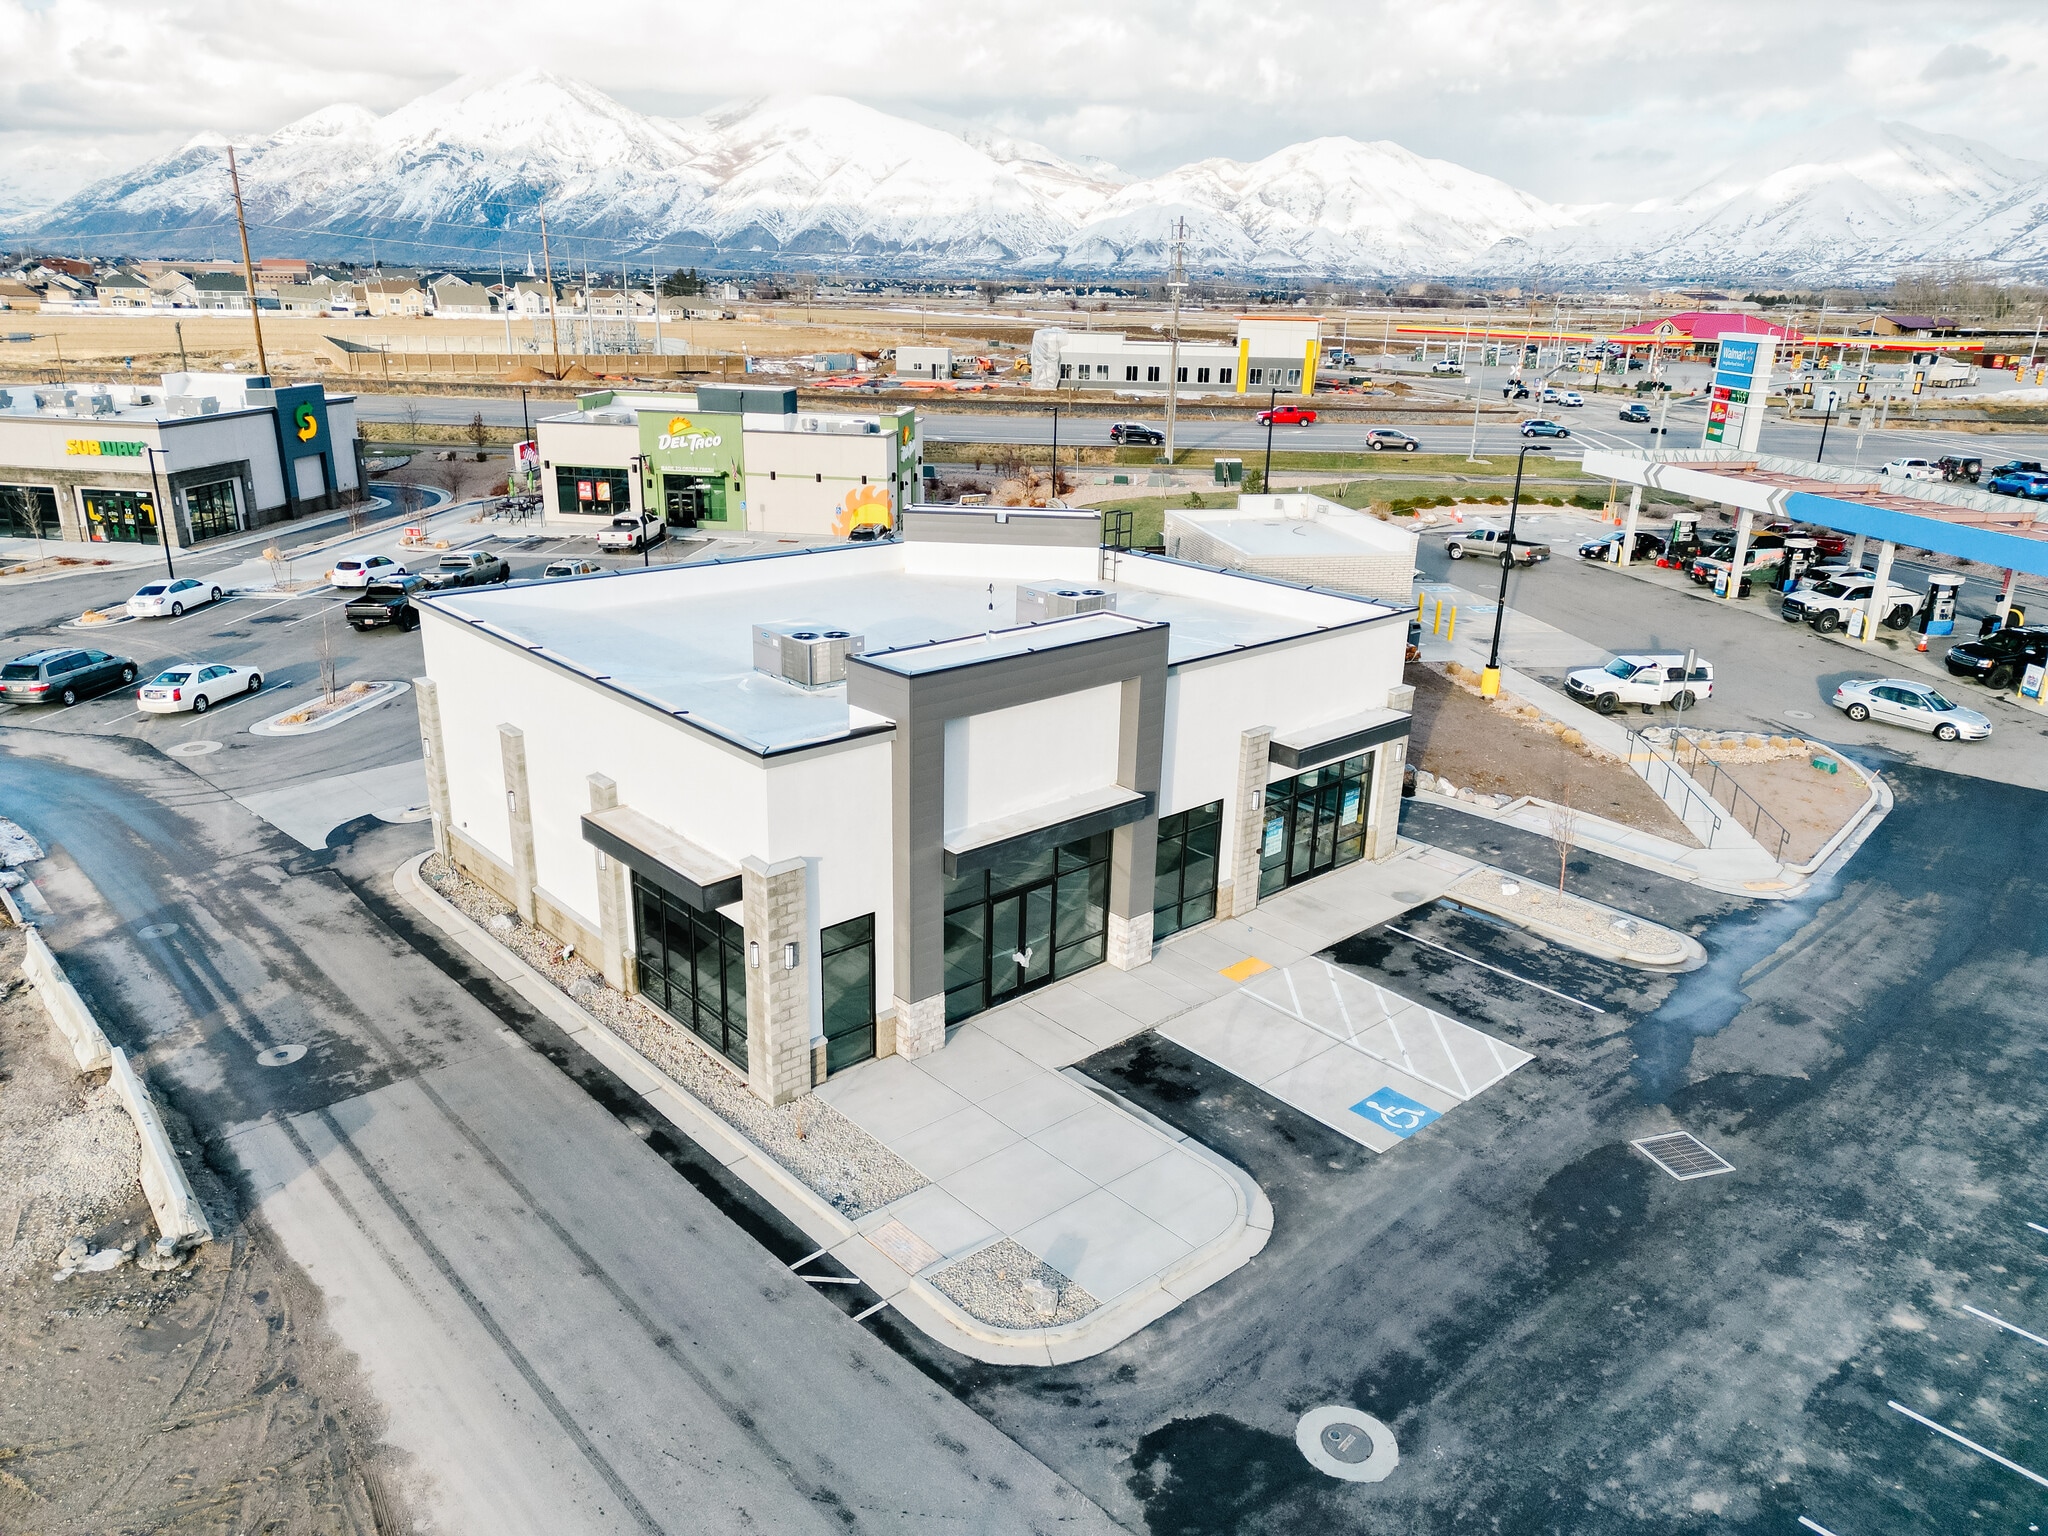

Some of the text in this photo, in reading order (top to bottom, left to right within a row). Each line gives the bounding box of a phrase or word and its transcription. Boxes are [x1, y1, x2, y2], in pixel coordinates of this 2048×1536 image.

[1723, 347, 1747, 360] Walmart
[65, 439, 145, 456] SUBWAY
[658, 433, 722, 452] DEL TACO
